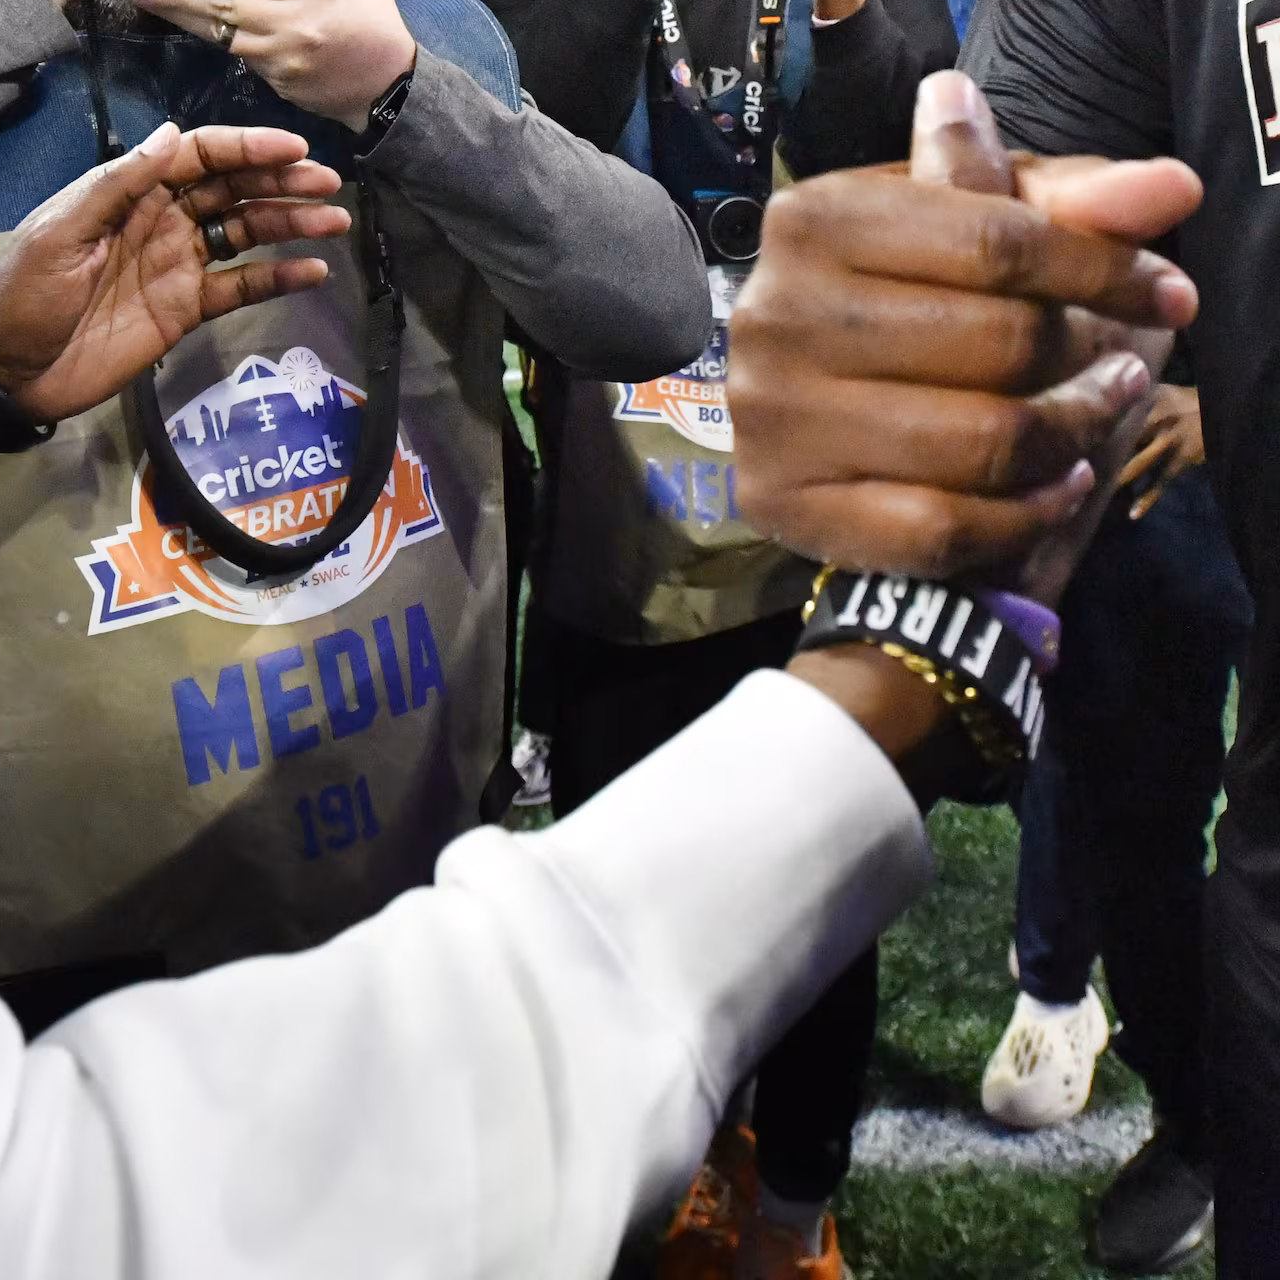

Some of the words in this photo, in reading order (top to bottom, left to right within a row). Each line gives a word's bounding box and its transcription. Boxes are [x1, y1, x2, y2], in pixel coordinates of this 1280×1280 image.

[657, 378, 727, 401] CELEBR
[197, 434, 342, 504] cricket
[647, 457, 739, 521] ME
[256, 581, 297, 603] MEAC
[311, 564, 350, 586] SWAC
[837, 575, 1003, 680] FIRST
[172, 601, 446, 786] MEDIA
[296, 774, 382, 860] 191
